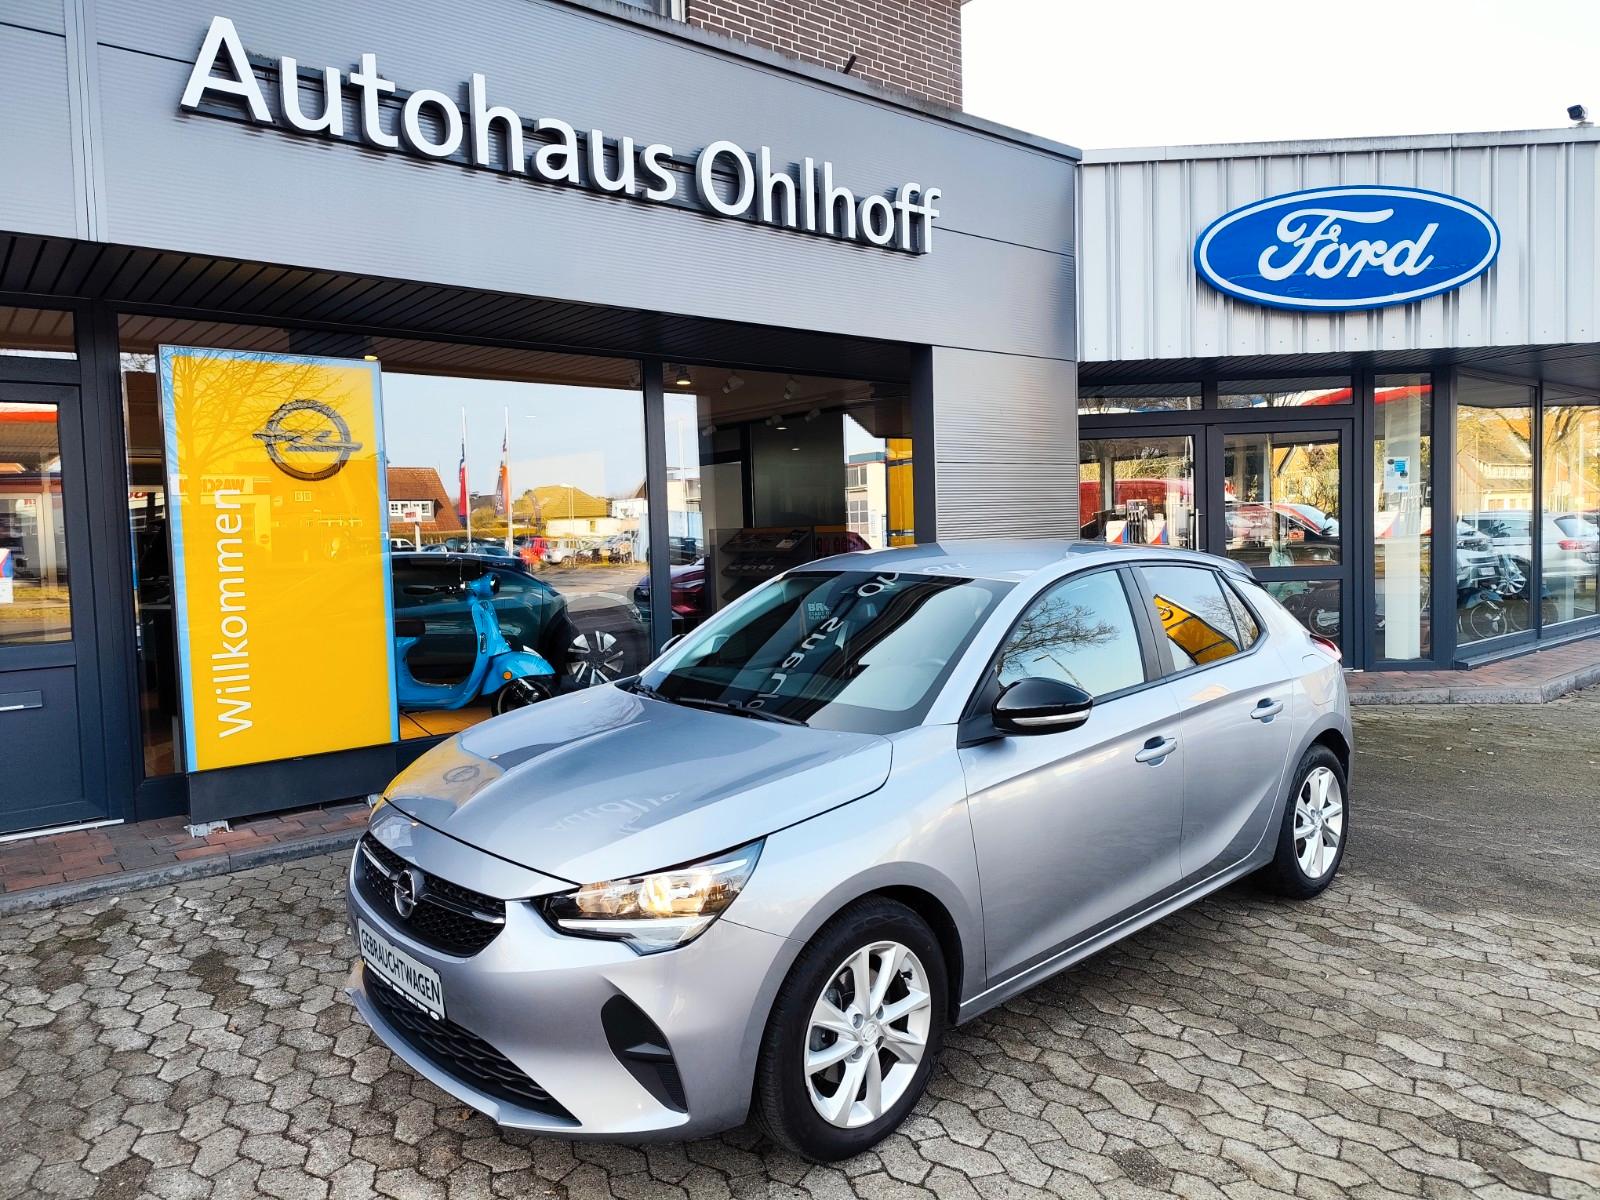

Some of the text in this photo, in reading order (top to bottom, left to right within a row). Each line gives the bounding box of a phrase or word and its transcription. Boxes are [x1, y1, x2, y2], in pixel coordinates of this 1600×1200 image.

[180, 16, 941, 253] Autohaus Ohlhoff
[1258, 208, 1439, 281] Ford
[211, 489, 253, 738] Willkommen
[361, 929, 440, 1005] GEBRAUCHTWAGEN
